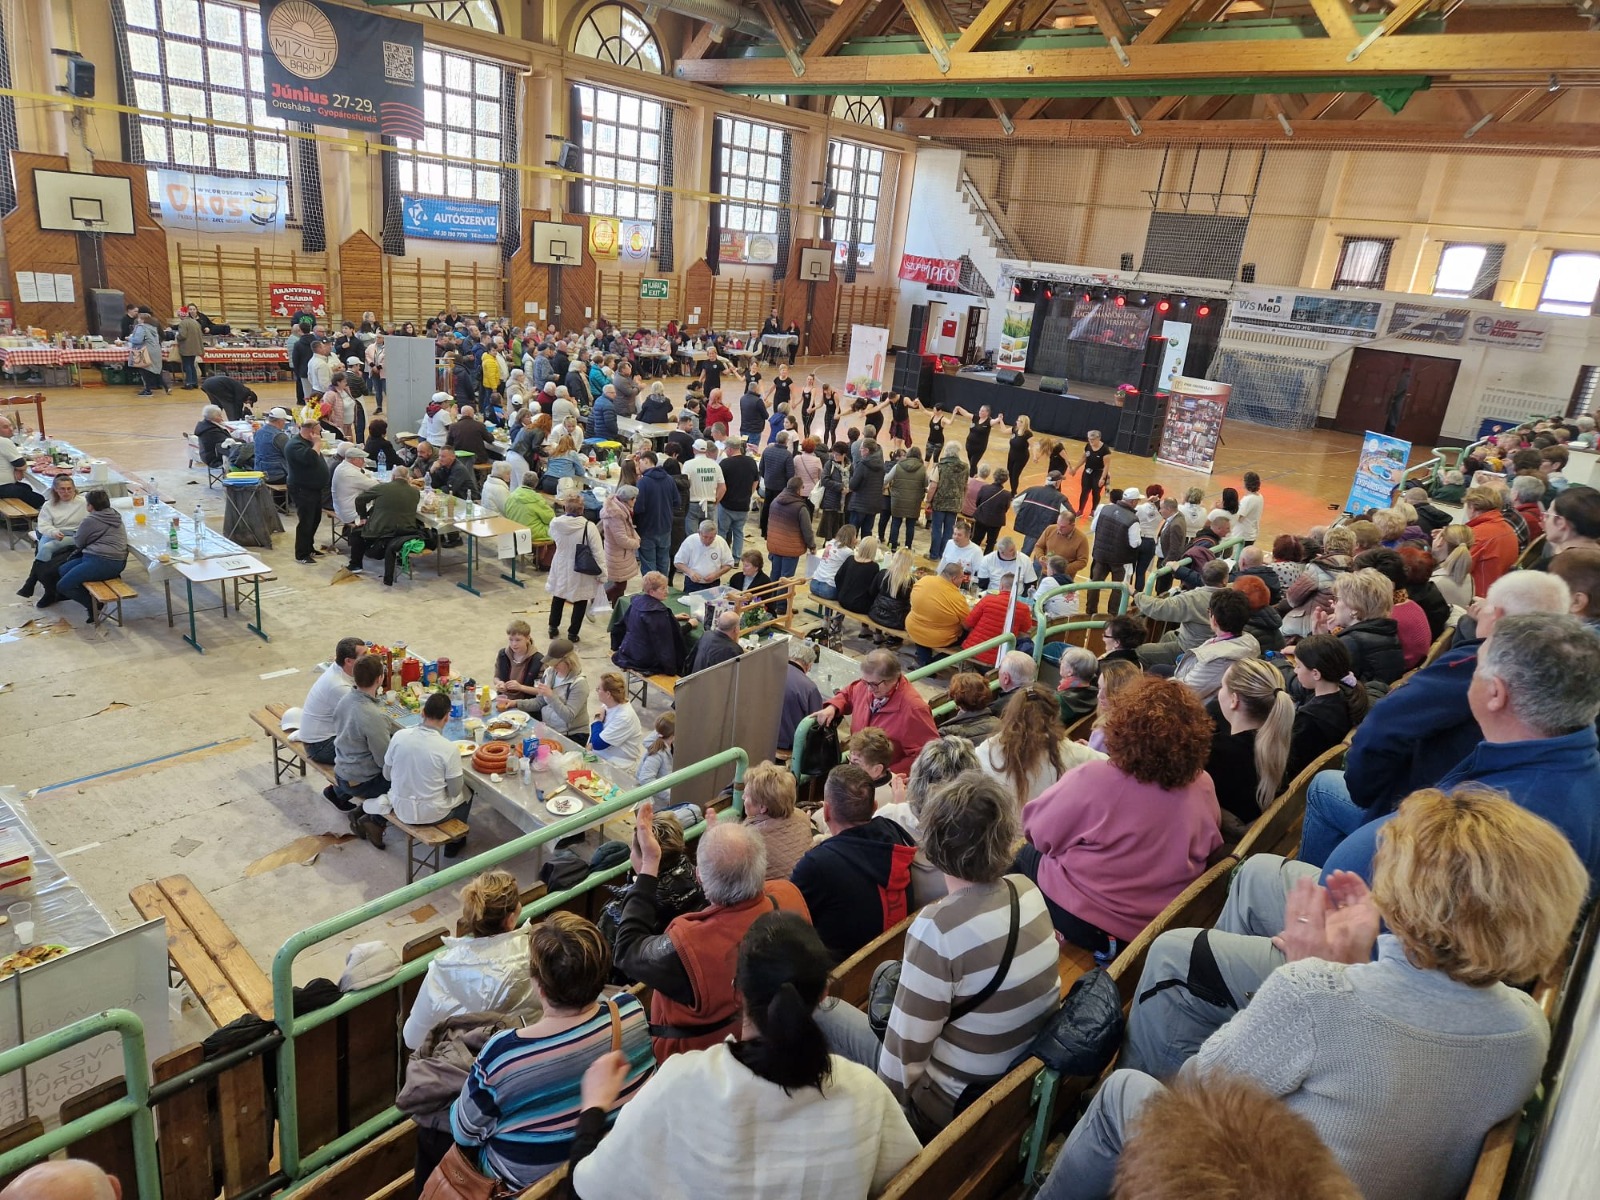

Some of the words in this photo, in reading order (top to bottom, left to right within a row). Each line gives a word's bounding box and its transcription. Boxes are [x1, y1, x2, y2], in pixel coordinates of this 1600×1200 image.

[271, 83, 329, 106] Június
[332, 93, 376, 114] 27-29.
[272, 100, 311, 113] Orosháza
[317, 106, 378, 123] Gyopárosfürdő
[433, 212, 496, 226] AUTÓSZERVIZ
[273, 287, 322, 296] ARANYPATKÓ
[1239, 300, 1256, 311] WS
[1257, 302, 1281, 314] MeD
[521, 533, 527, 543] 9
